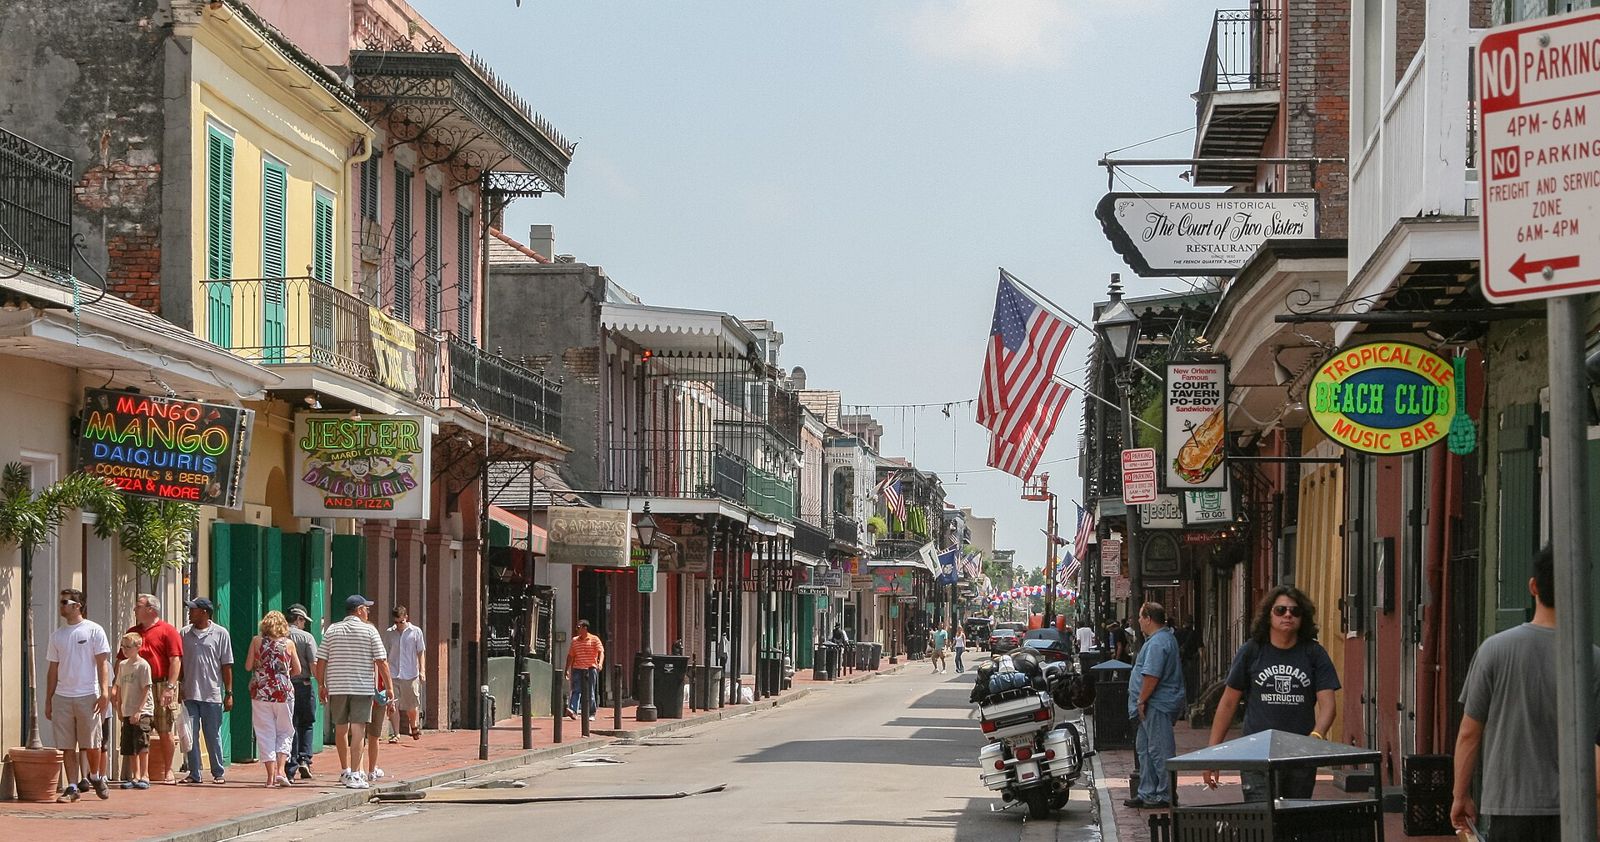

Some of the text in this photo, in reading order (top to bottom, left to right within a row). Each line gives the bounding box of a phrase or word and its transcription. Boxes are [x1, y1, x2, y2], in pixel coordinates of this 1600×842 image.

[1481, 46, 1517, 100] NO
[1493, 139, 1600, 176] NO PARKING
[1489, 181, 1530, 203] FREIGHT
[1536, 177, 1557, 196] AND
[1169, 201, 1276, 210] FAMOUS HISTORICAL
[1532, 198, 1562, 219] ZONE
[1142, 210, 1305, 242] The Court of Two Sisters
[1185, 244, 1261, 253] RESTAURANT
[1323, 346, 1455, 386] TROPICAL ISLE
[1172, 381, 1218, 389] COURT
[116, 396, 201, 423] MANGO
[1170, 398, 1220, 406] PO-BOY
[1314, 382, 1450, 416] BEACH CLUB
[85, 410, 229, 456] MANGO
[301, 417, 423, 453] JESTER
[1331, 418, 1440, 450] MUSIC BAR
[93, 443, 218, 474] DAIQUIRIS
[331, 448, 393, 461] MARDI GRAS
[1131, 451, 1152, 460] PARKING
[95, 462, 210, 485] COCKTAILS & BEER
[303, 470, 416, 498] DAIQUIRIS
[1132, 472, 1153, 480] PARKING
[104, 476, 201, 500] PIZZA & MORE
[325, 498, 392, 508] AND PIZZA
[1254, 664, 1312, 688] LONGBOARD
[1260, 693, 1305, 703] INSTRUCTOR
